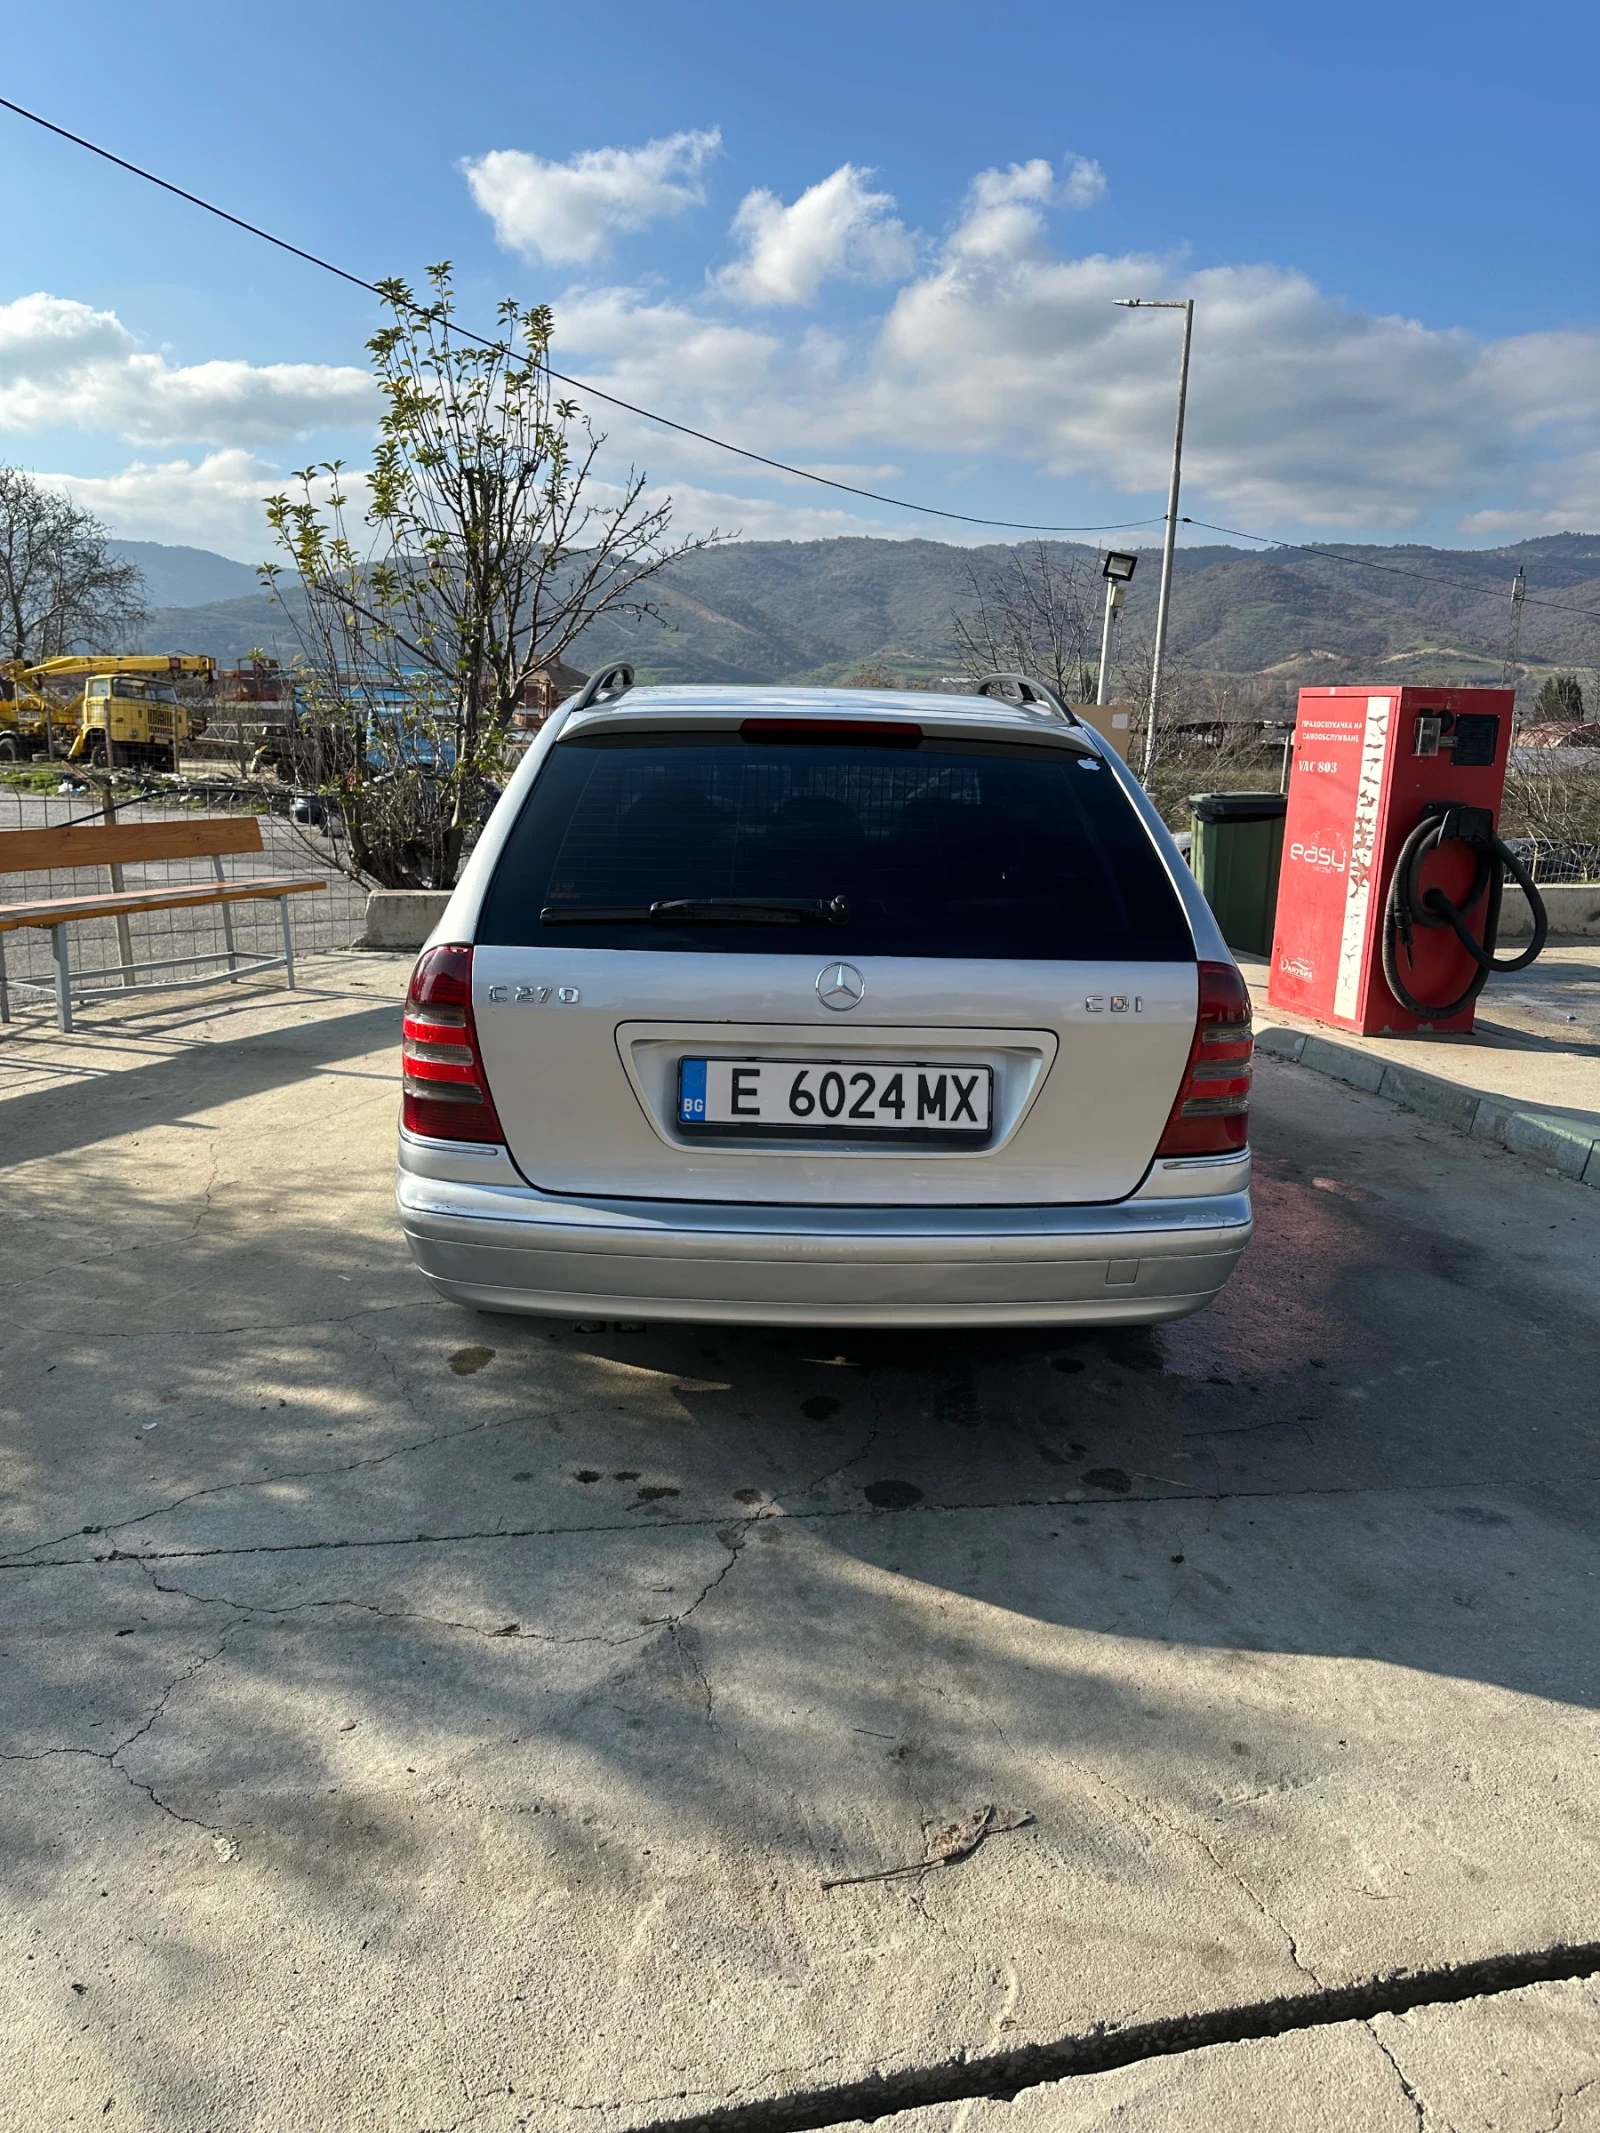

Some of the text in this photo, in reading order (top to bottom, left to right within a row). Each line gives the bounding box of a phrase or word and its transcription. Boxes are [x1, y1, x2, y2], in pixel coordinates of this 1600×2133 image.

[1298, 760, 1338, 774] VAC 803
[1290, 842, 1347, 873] easy
[488, 985, 580, 1004] C 270
[1085, 995, 1143, 1013] CDI
[730, 1067, 980, 1123] E 6024 MX
[683, 1097, 704, 1113] BG
